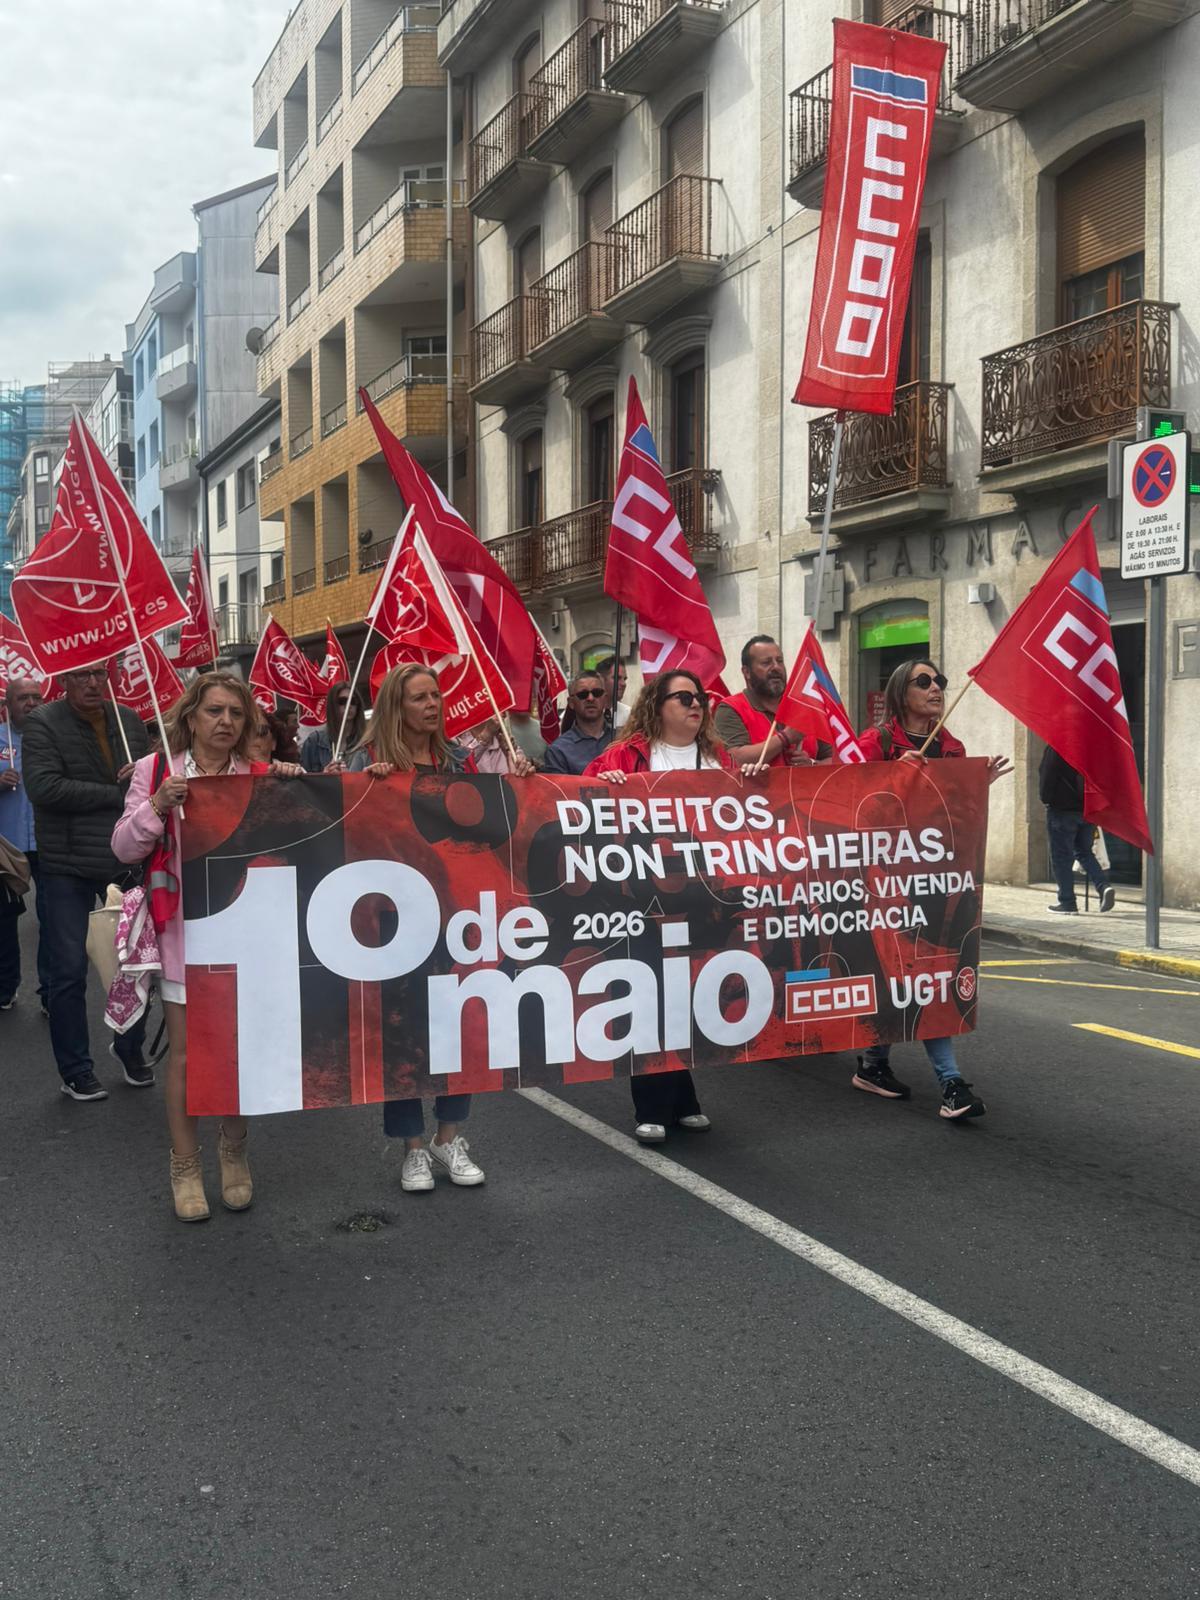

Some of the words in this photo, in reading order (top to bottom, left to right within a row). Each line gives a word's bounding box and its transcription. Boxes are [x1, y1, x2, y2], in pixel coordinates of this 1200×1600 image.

[835, 116, 908, 358] CCOO
[1125, 531, 1134, 539] DE
[1176, 522, 1181, 530] E
[1139, 513, 1168, 525] LABORAIS
[863, 499, 1116, 583] FARMACI
[1127, 542, 1135, 550] DE
[1151, 538, 1157, 546] A
[1147, 546, 1176, 558] SERVIZOS
[1156, 557, 1181, 568] MINUTOS
[556, 795, 785, 835] DEREITOS,
[564, 843, 667, 884] NON
[673, 827, 955, 878] TRINCHEIRAS.
[742, 879, 870, 909] SALARIOS,
[875, 870, 976, 899] VIVENDA
[446, 891, 550, 965] de
[573, 910, 645, 941] 2026
[743, 918, 759, 942] E
[765, 905, 928, 941] DEMOCRACIA
[428, 922, 775, 1074] maio
[792, 984, 870, 1014] CCOO
[890, 970, 952, 1009] UGT
